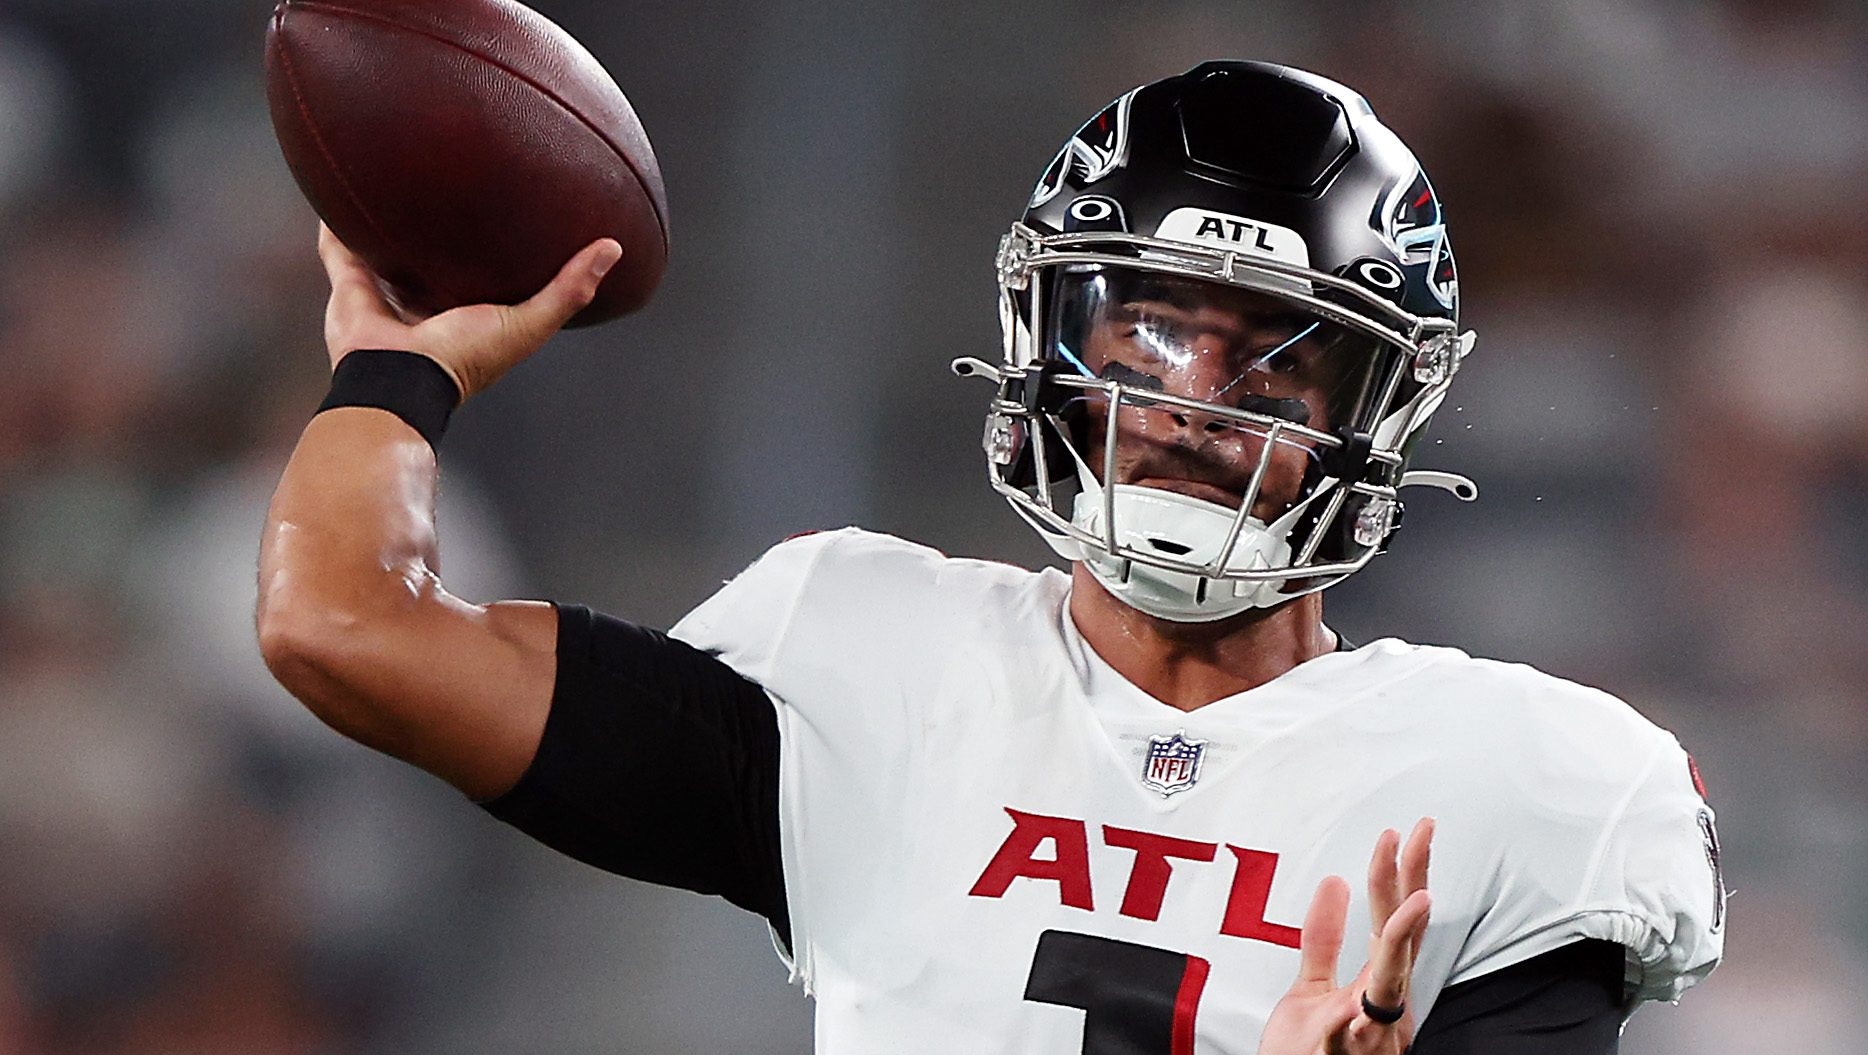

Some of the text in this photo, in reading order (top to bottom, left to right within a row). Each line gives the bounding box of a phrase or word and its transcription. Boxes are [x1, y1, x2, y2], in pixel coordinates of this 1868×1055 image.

[1196, 216, 1274, 252] ATL
[1151, 758, 1188, 782] NFL
[968, 806, 1302, 949] ATL
